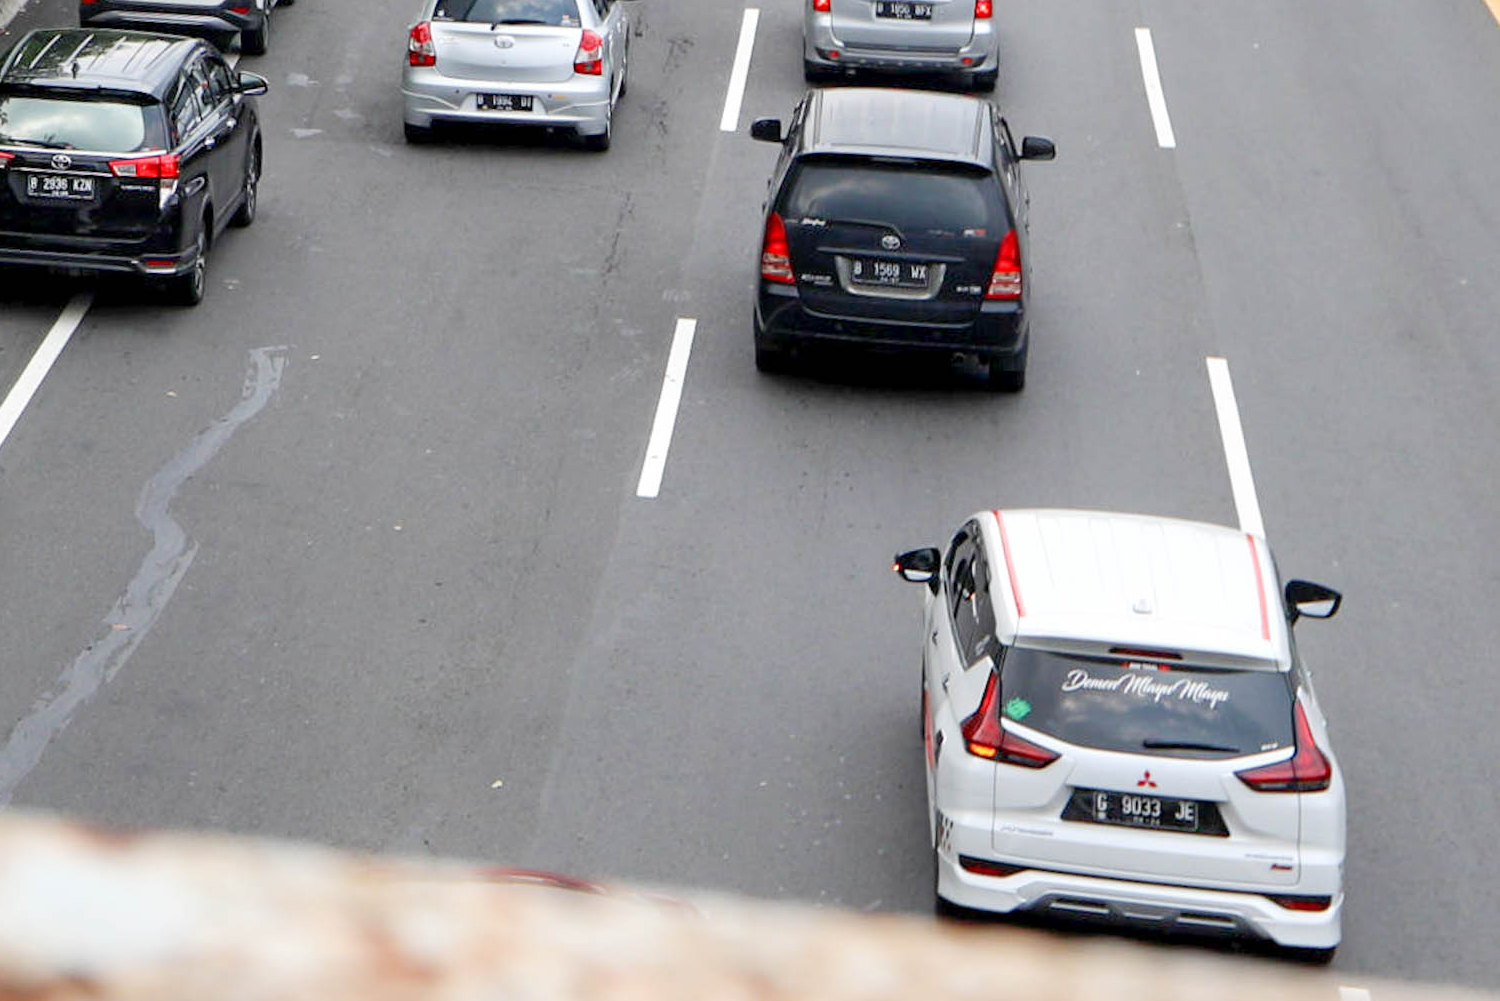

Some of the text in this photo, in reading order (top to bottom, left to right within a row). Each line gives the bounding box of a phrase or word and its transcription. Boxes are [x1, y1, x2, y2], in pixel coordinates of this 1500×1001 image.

[30, 176, 38, 189] B
[854, 260, 862, 275] B
[911, 265, 927, 279] WX
[1061, 668, 1230, 710] Demen Mlayu Mlayu
[1097, 792, 1108, 811] G
[1121, 795, 1161, 818] 9033
[1174, 800, 1195, 821] JE
